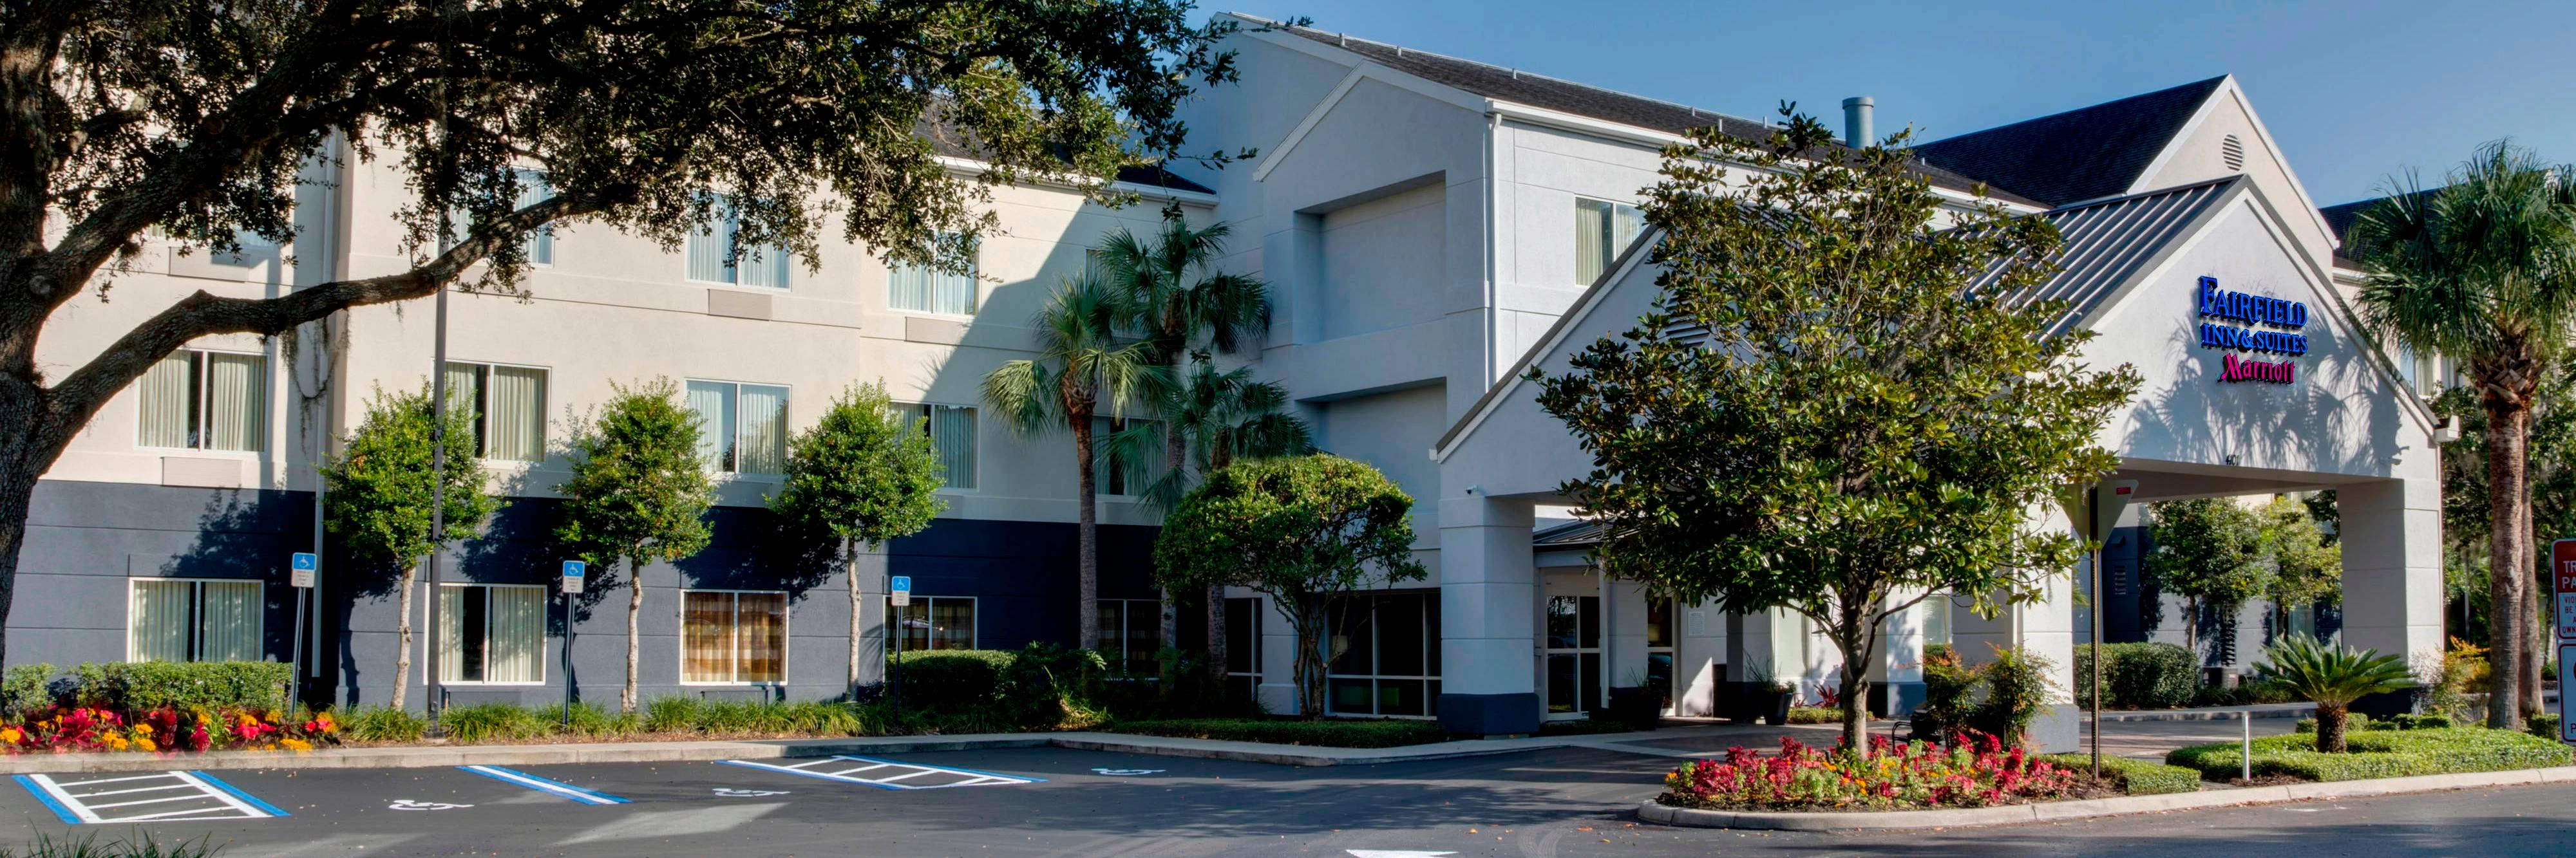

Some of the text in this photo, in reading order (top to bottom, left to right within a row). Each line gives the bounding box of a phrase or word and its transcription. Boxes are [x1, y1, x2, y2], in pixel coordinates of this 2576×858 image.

[2199, 275, 2307, 327] FAIRFIELD
[2255, 330, 2307, 354] SUITES
[2219, 353, 2295, 384] Marriott
